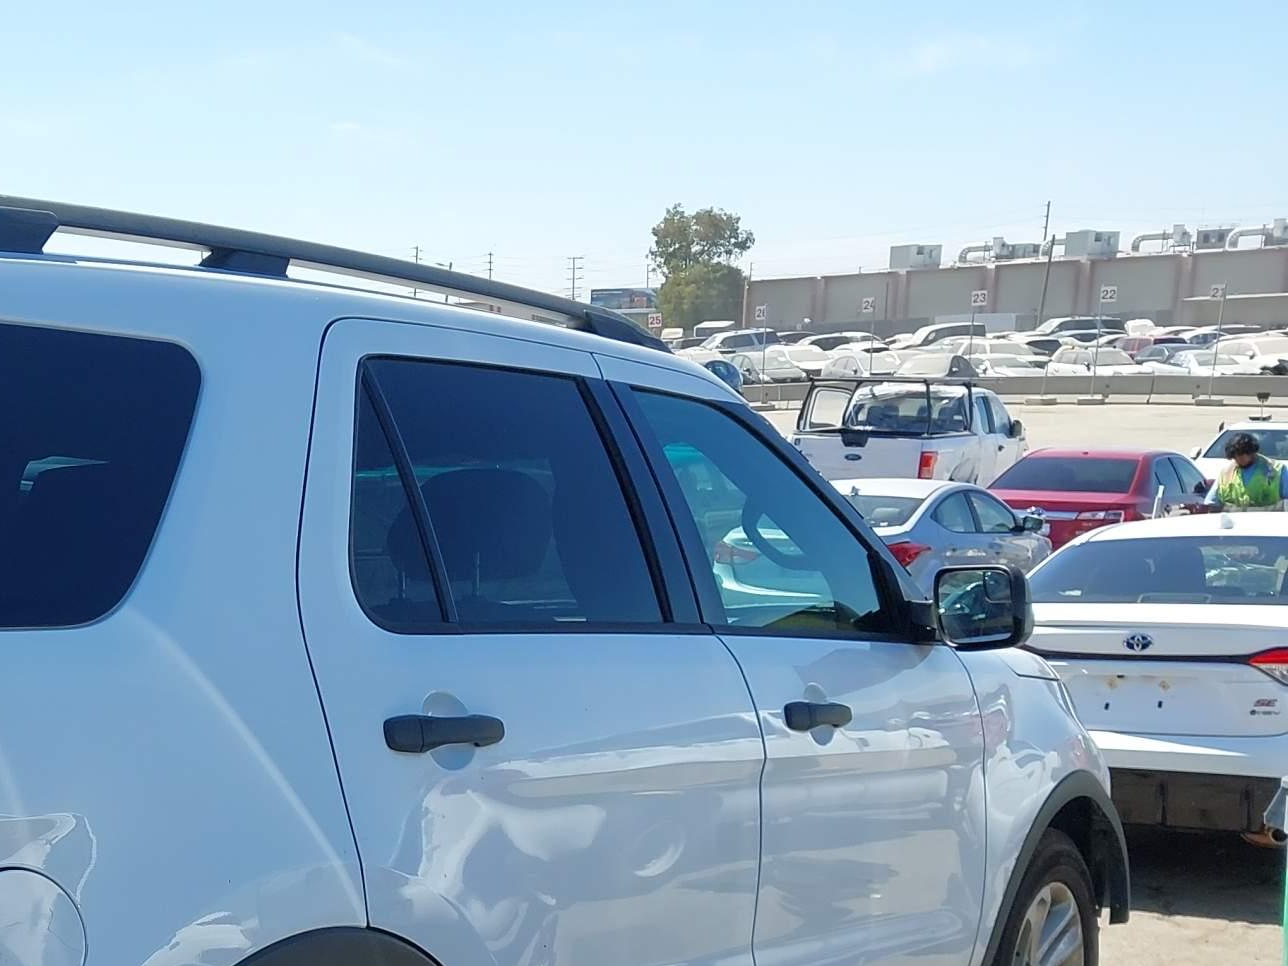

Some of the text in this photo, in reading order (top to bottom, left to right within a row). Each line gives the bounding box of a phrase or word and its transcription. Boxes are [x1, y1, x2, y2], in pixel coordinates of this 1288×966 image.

[972, 293, 987, 304] 23
[1101, 289, 1116, 300] 22
[649, 315, 662, 326] 25
